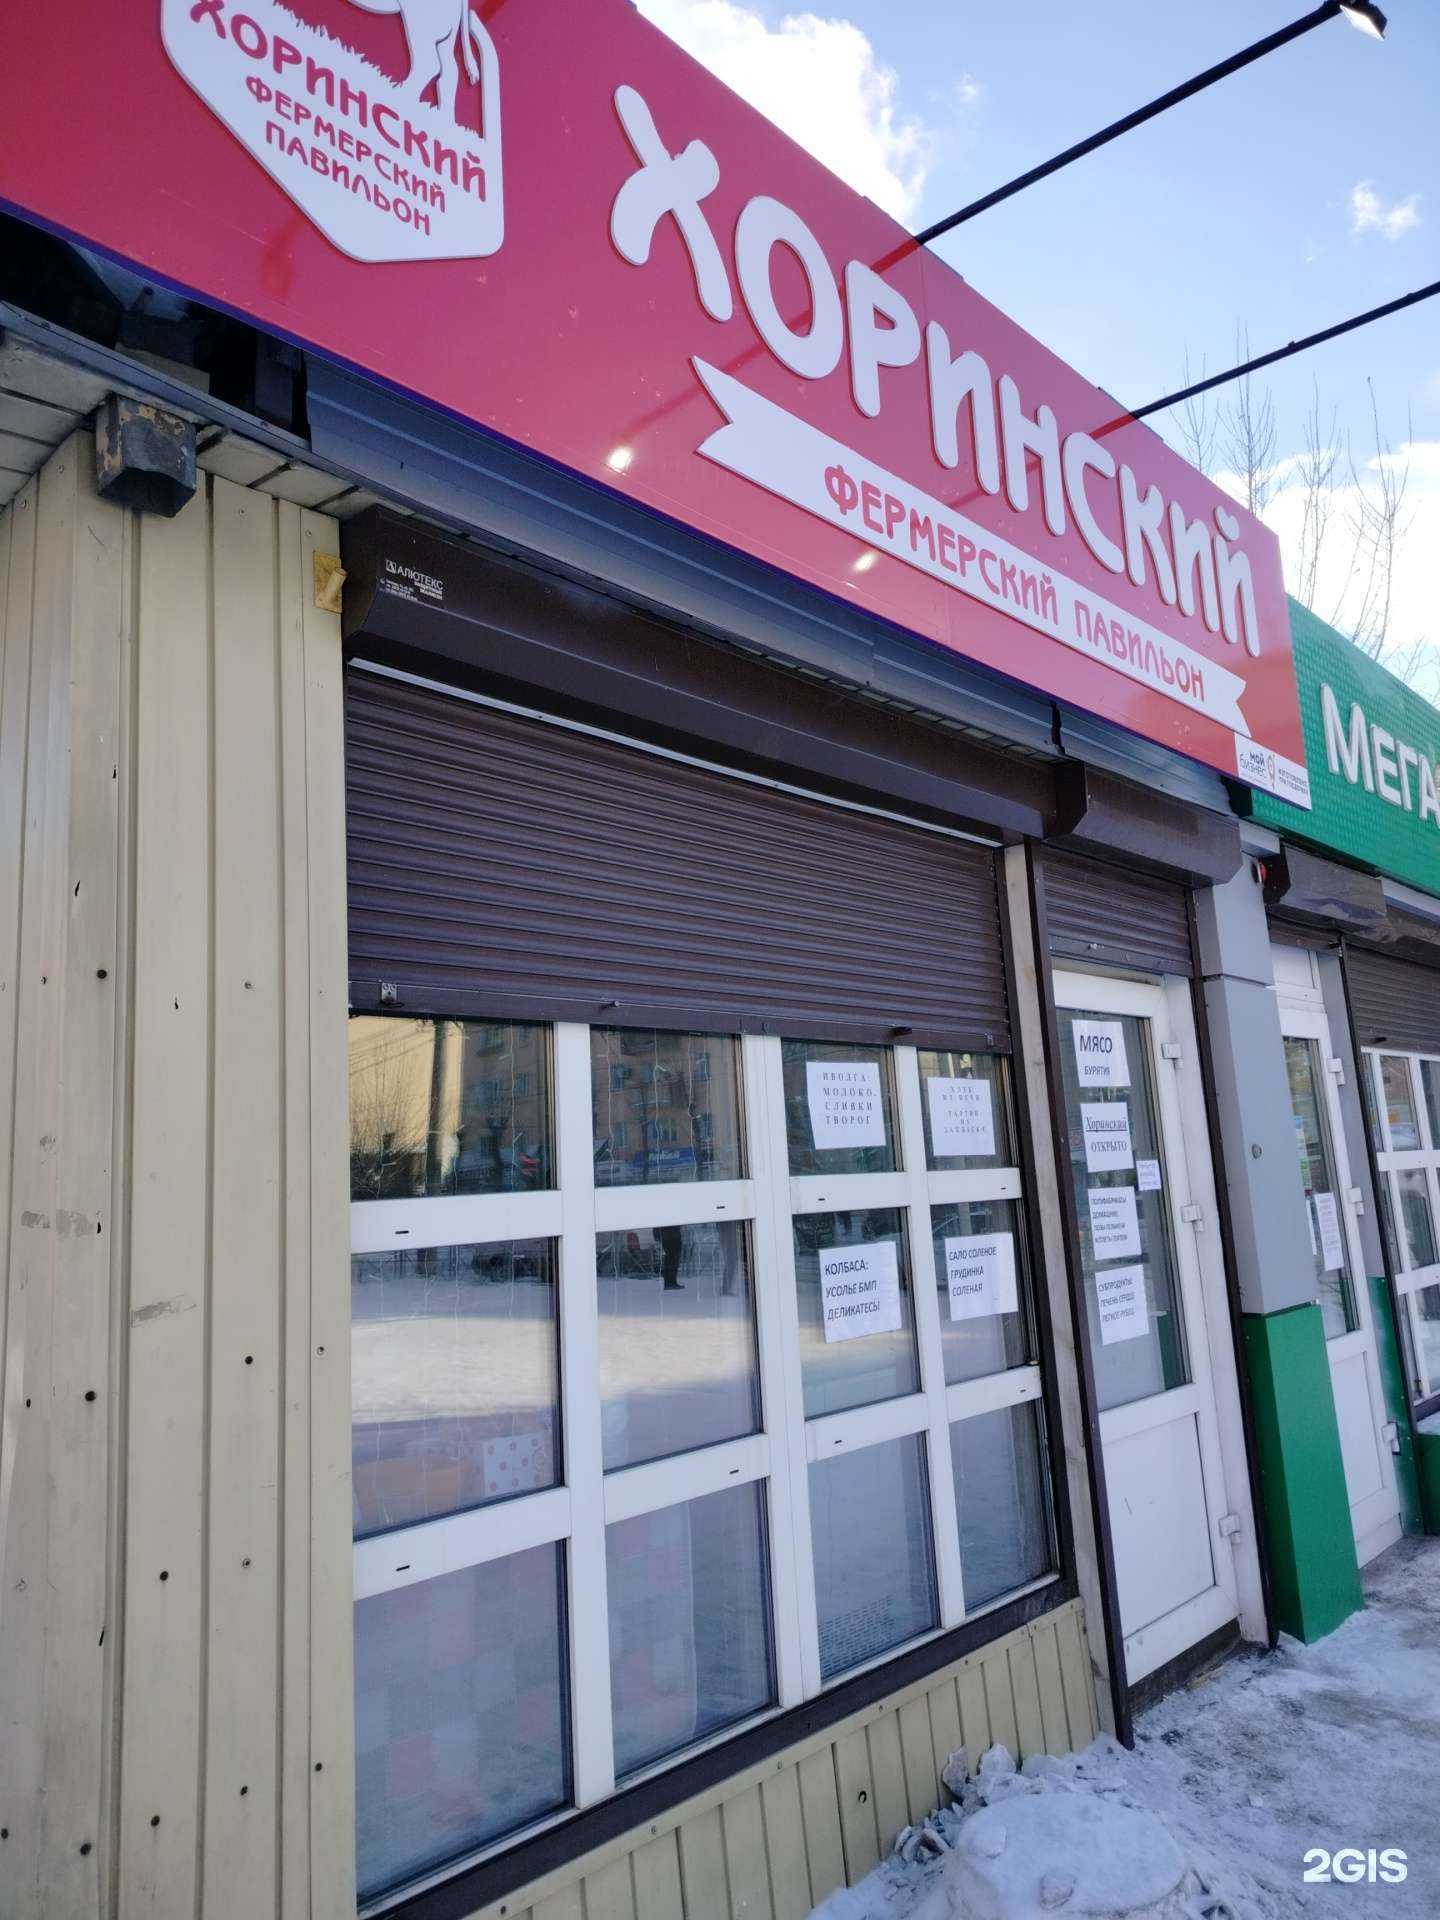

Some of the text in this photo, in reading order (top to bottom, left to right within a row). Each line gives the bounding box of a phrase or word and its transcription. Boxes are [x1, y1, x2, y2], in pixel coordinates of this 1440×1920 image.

[246, 75, 445, 213] ФЕРМЕРСКИЙ
[266, 120, 431, 236] ПАВИЛЬОН
[611, 84, 1260, 657] ХОРИНСКИЙ
[824, 464, 1205, 702] ФЕРМЕРСКИЙ ПАВИЛЬОН
[1079, 1034, 1113, 1054] МЯСО
[825, 1101, 873, 1111] СЛИВКИ
[825, 1115, 870, 1125] ТВОРОГ
[1086, 1116, 1128, 1132] Хоринский
[1091, 1140, 1128, 1152] ОТКРЫТО
[949, 1246, 997, 1261] САЛО СОЛЕНОЕ
[825, 1258, 870, 1276] КОЛБАСА:
[950, 1265, 984, 1279] ГРУДИНКА
[825, 1280, 877, 1299] УСОЛЬЕ БМП
[952, 1283, 983, 1297] СОЛЕНАЯ
[827, 1301, 880, 1321] ДЕЛИКАТЕСЫ
